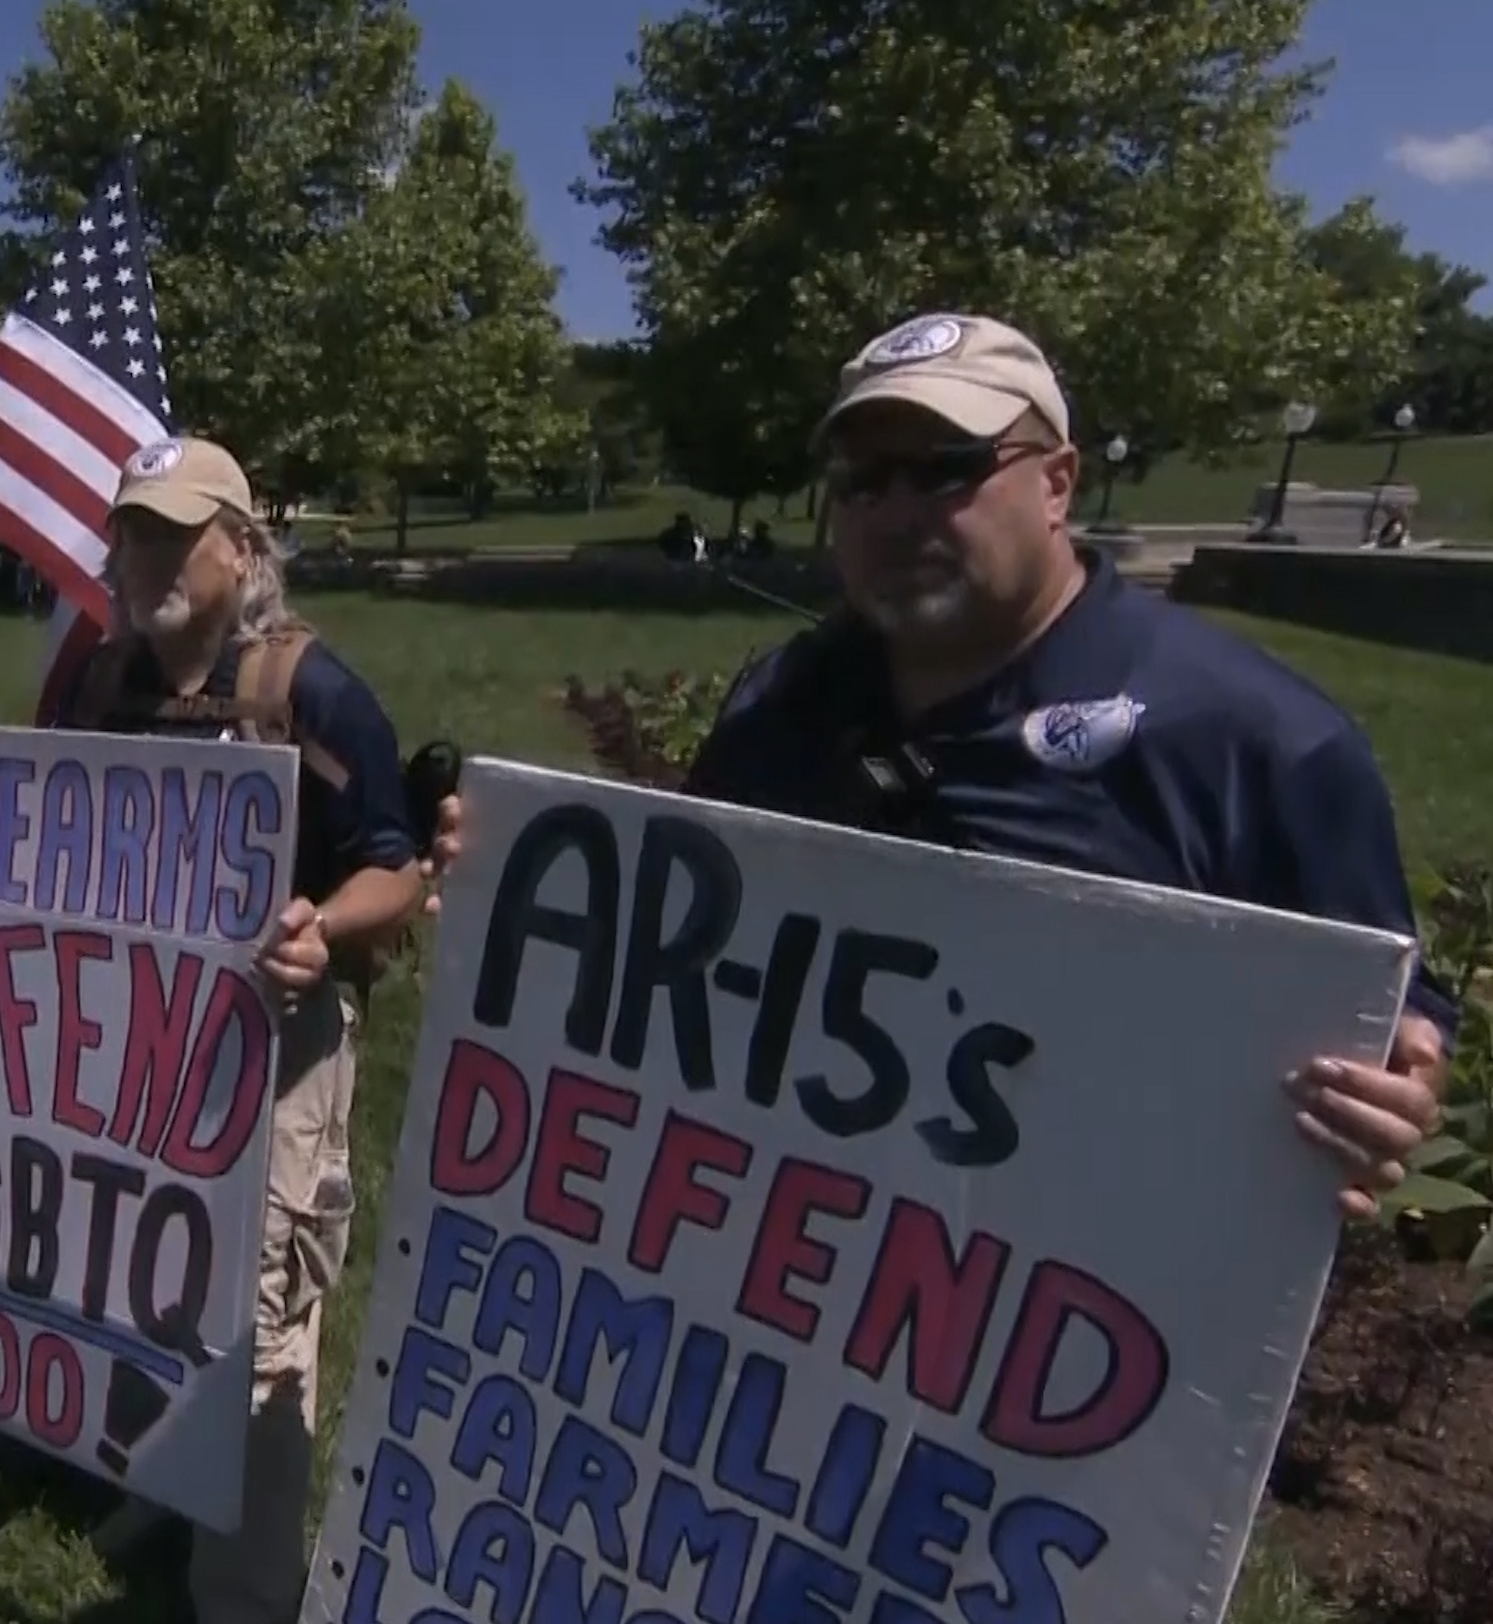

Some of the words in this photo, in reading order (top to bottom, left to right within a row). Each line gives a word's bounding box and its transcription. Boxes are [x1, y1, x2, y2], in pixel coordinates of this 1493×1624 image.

[414, 1206, 1108, 1624] FAMILIES
[430, 1038, 1170, 1458] DEFEND
[359, 1437, 699, 1624] RAN
[389, 1326, 957, 1624] FARME
